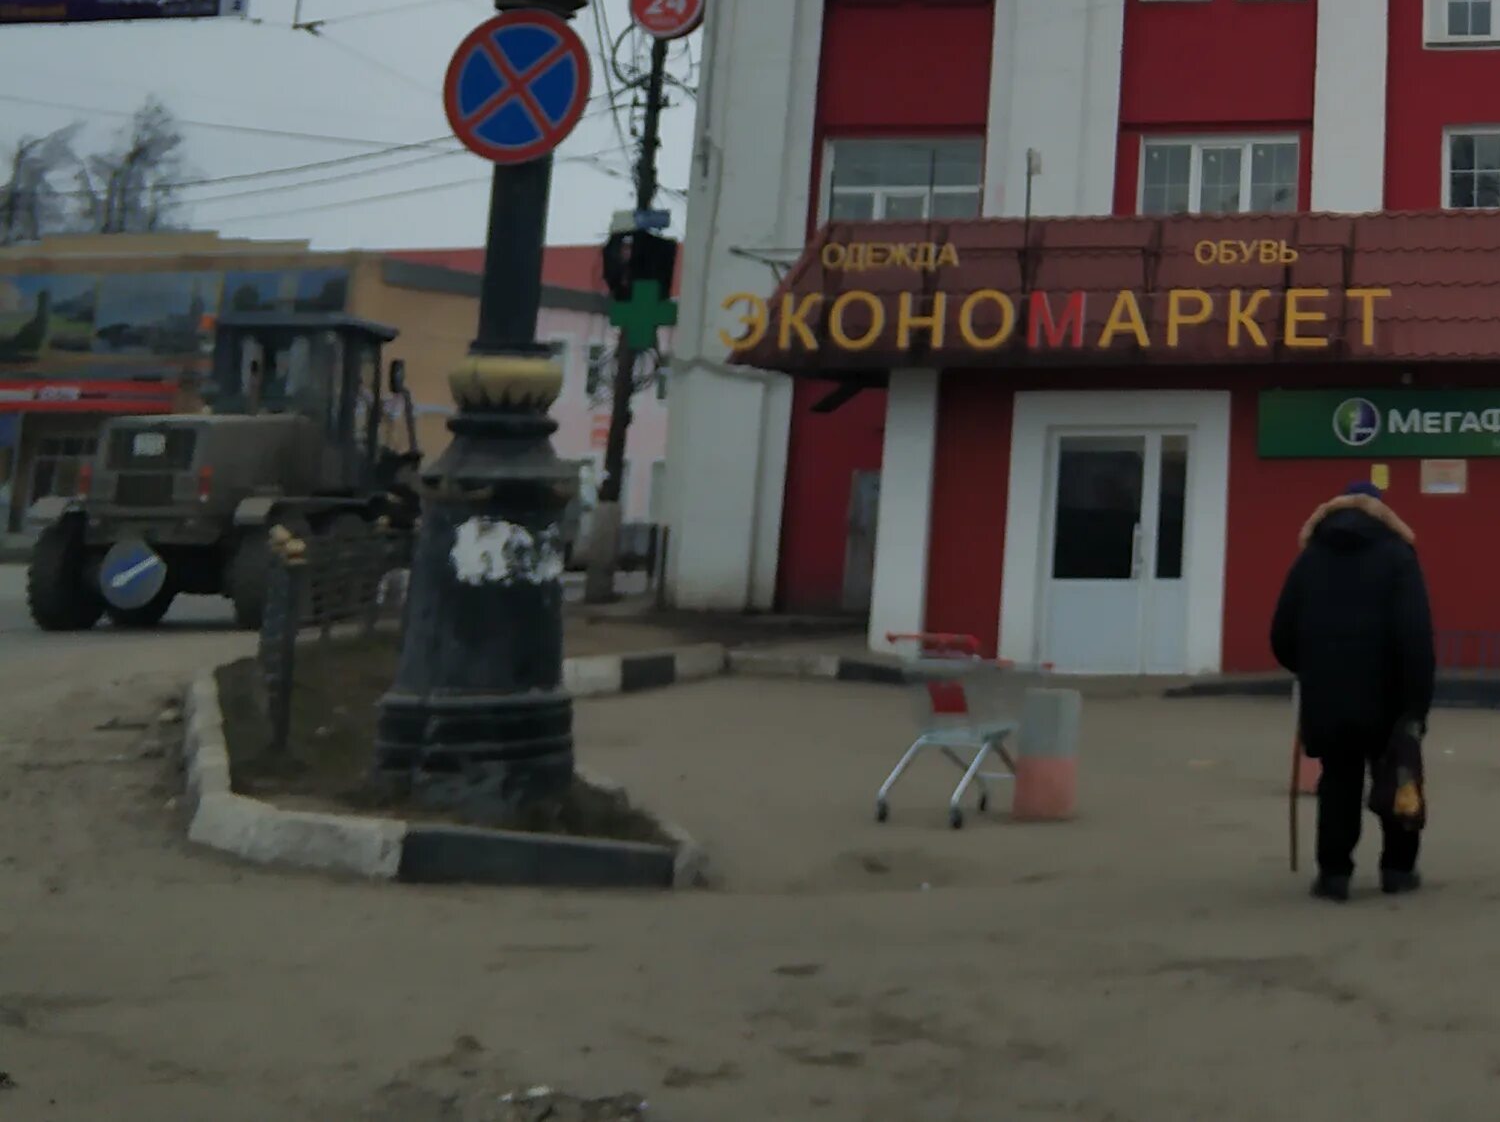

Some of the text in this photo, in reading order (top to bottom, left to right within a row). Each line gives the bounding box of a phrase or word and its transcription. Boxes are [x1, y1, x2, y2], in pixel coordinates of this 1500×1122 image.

[822, 241, 959, 271] ОДЕЖДА
[1194, 239, 1298, 265] ОБУВЬ
[718, 288, 1392, 351] ЭКОНОМАРКЕТ
